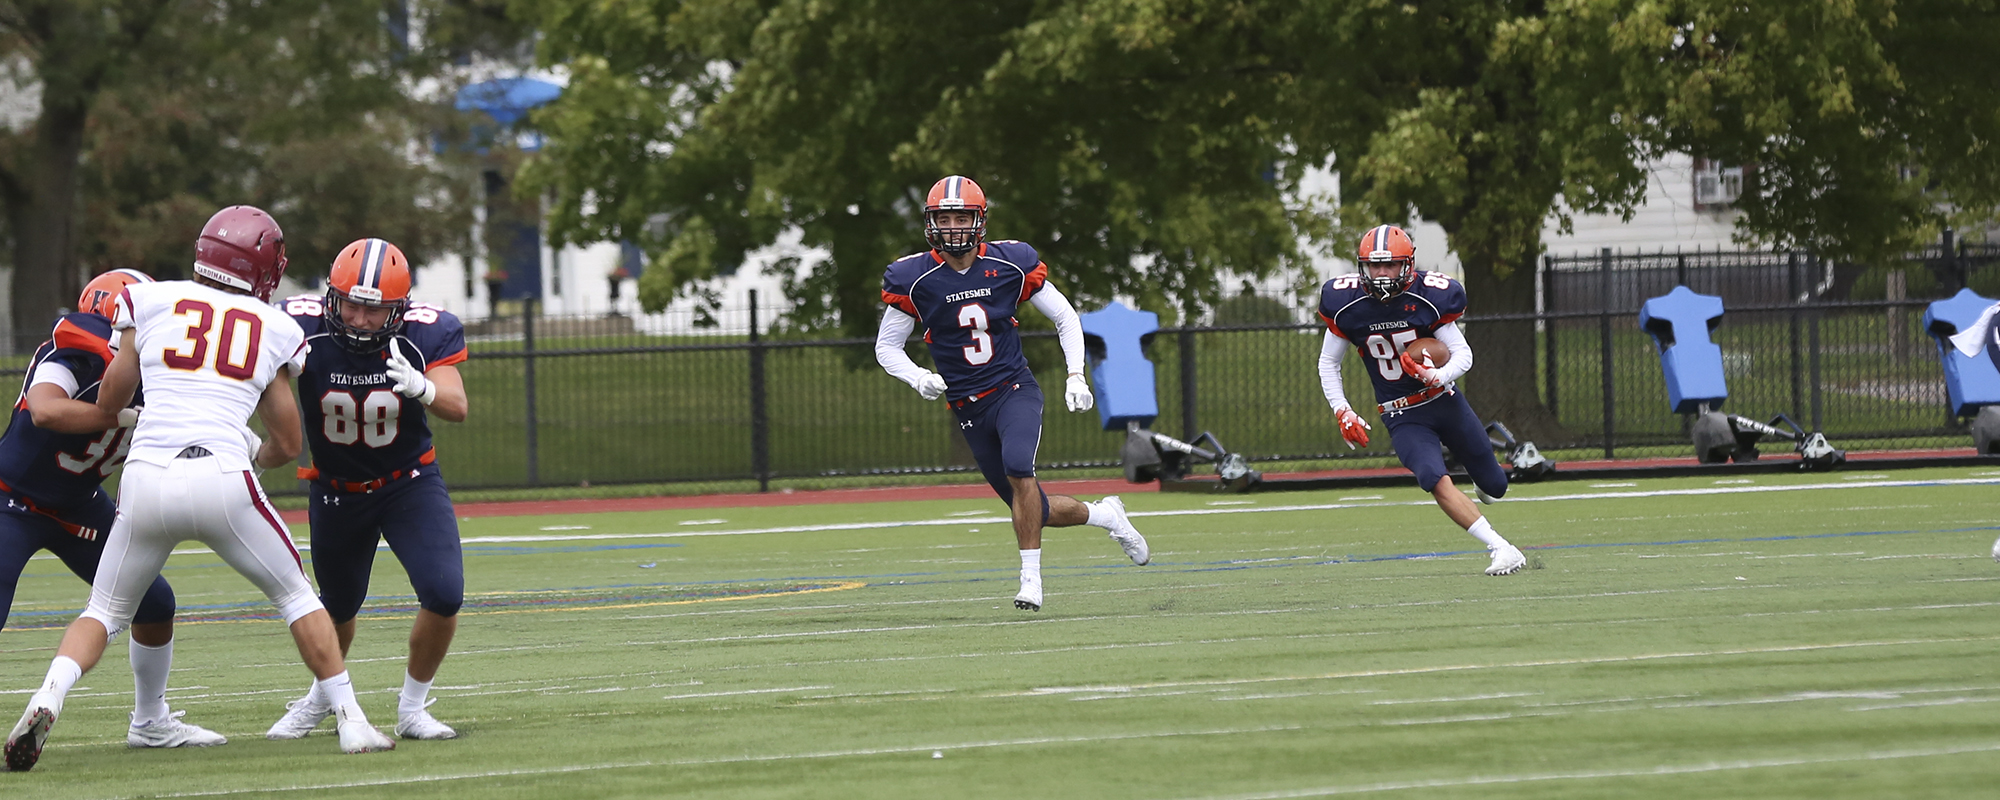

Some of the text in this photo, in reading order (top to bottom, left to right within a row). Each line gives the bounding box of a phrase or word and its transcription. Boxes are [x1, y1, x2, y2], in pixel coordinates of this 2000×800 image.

[197, 266, 232, 284] CARDINALS
[284, 294, 323, 317] 8
[945, 287, 992, 304] STATESMEN
[402, 301, 446, 325] 8
[957, 302, 995, 367] 3
[1369, 320, 1409, 331] STATESMEN
[162, 298, 264, 382] 30
[1366, 328, 1418, 382] 85
[330, 372, 387, 386] STATESMEN
[319, 388, 402, 449] 88
